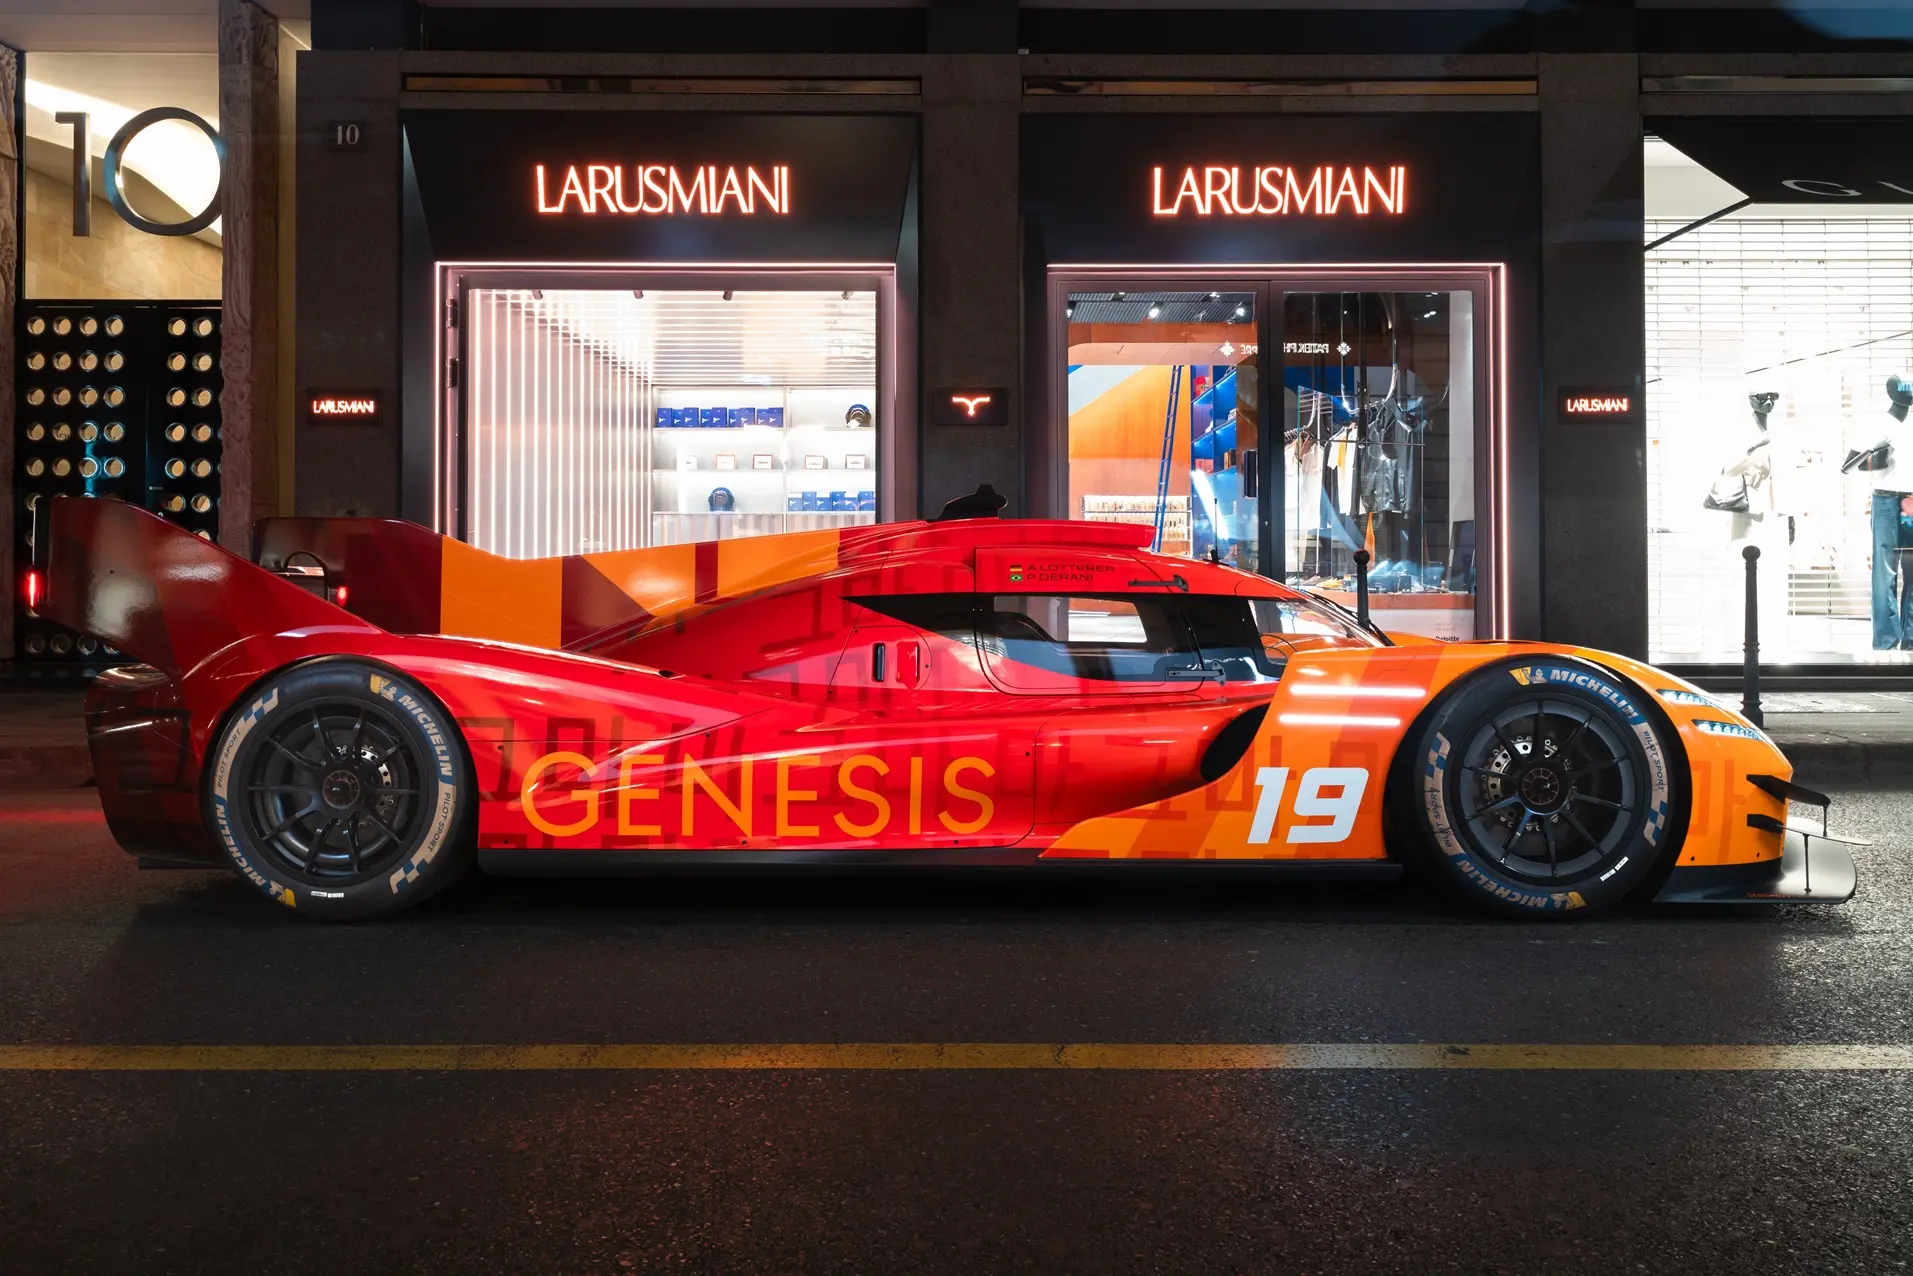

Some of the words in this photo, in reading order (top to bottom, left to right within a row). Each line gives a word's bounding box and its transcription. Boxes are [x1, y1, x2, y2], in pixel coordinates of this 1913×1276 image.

[336, 124, 360, 146] 10
[55, 107, 222, 238] 10
[536, 164, 789, 214] LARUSMIANI
[1153, 166, 1405, 215] LARUSMIANI
[313, 400, 375, 414] LARUSMIANI
[1567, 398, 1628, 412] LARUSMIANI
[1550, 669, 1639, 719] MICHELIN
[217, 761, 226, 788] PILOT
[224, 728, 241, 760] SPORT
[398, 694, 453, 778] MICHELIN
[1643, 730, 1658, 757] PILOT
[1654, 759, 1664, 792] SPORT
[441, 792, 451, 821] PILOT
[521, 751, 996, 838] GENESIS
[1247, 767, 1370, 844] 19
[1432, 787, 1441, 819] SPORT
[215, 803, 267, 887] MICHELIN
[428, 821, 445, 852] SPORT
[1435, 822, 1452, 848] PILOT
[1456, 859, 1548, 908] MICHELIN
